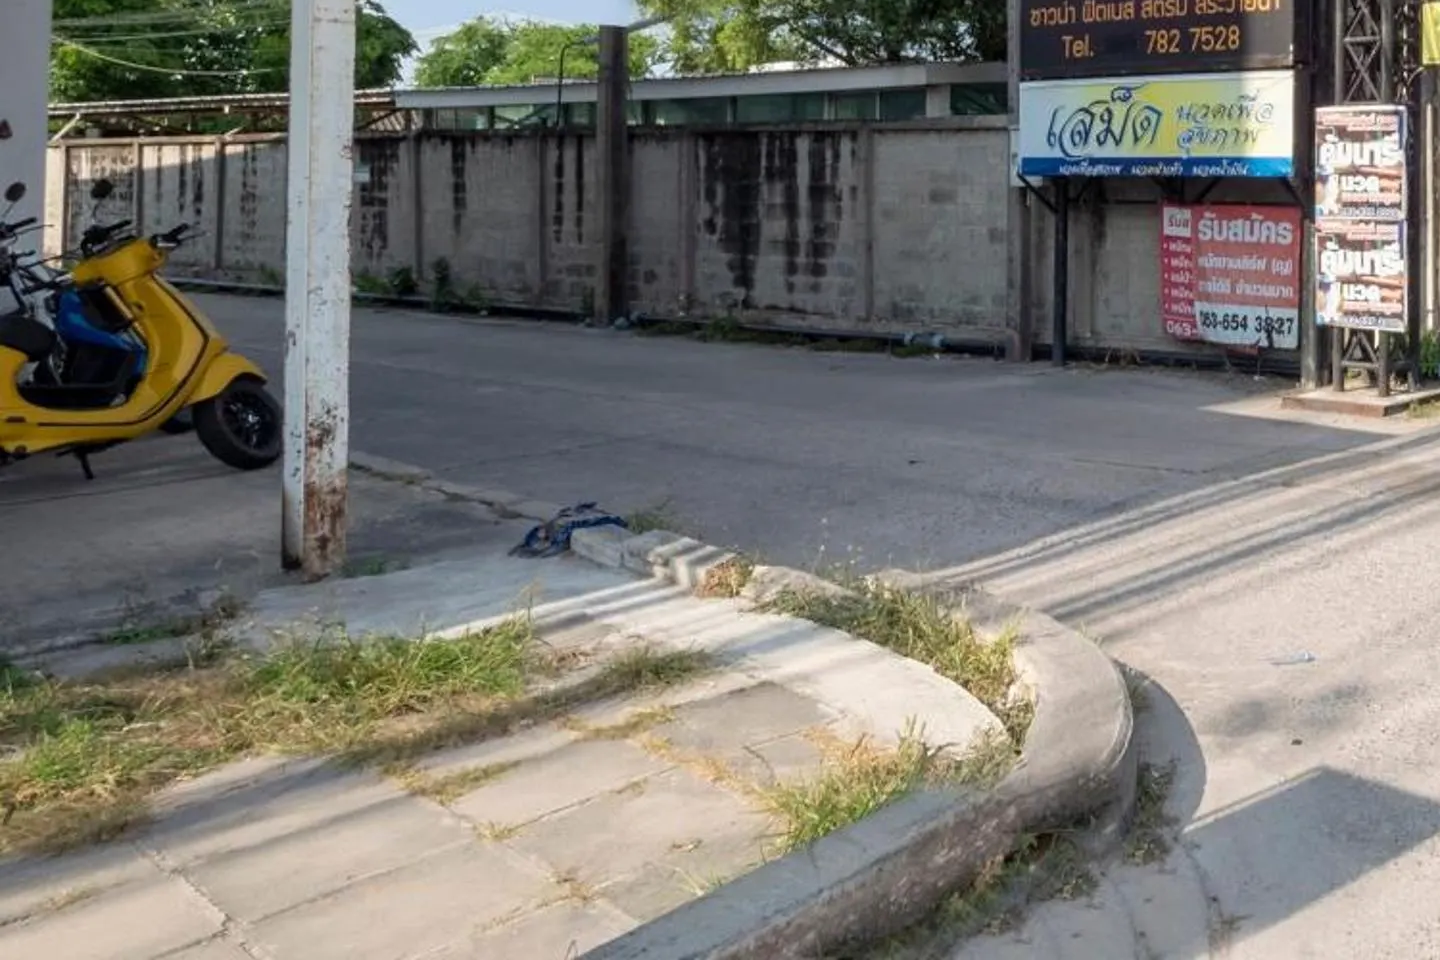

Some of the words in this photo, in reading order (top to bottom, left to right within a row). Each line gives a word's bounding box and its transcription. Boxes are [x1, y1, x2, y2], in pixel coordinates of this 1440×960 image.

[1082, 0, 1135, 24] ฟิตเนส
[1061, 35, 1095, 59] Tel.
[1143, 29, 1180, 54] 782
[1188, 26, 1240, 52] 7528
[1198, 212, 1293, 245] รับสมัคร
[1200, 310, 1249, 333] 63-654
